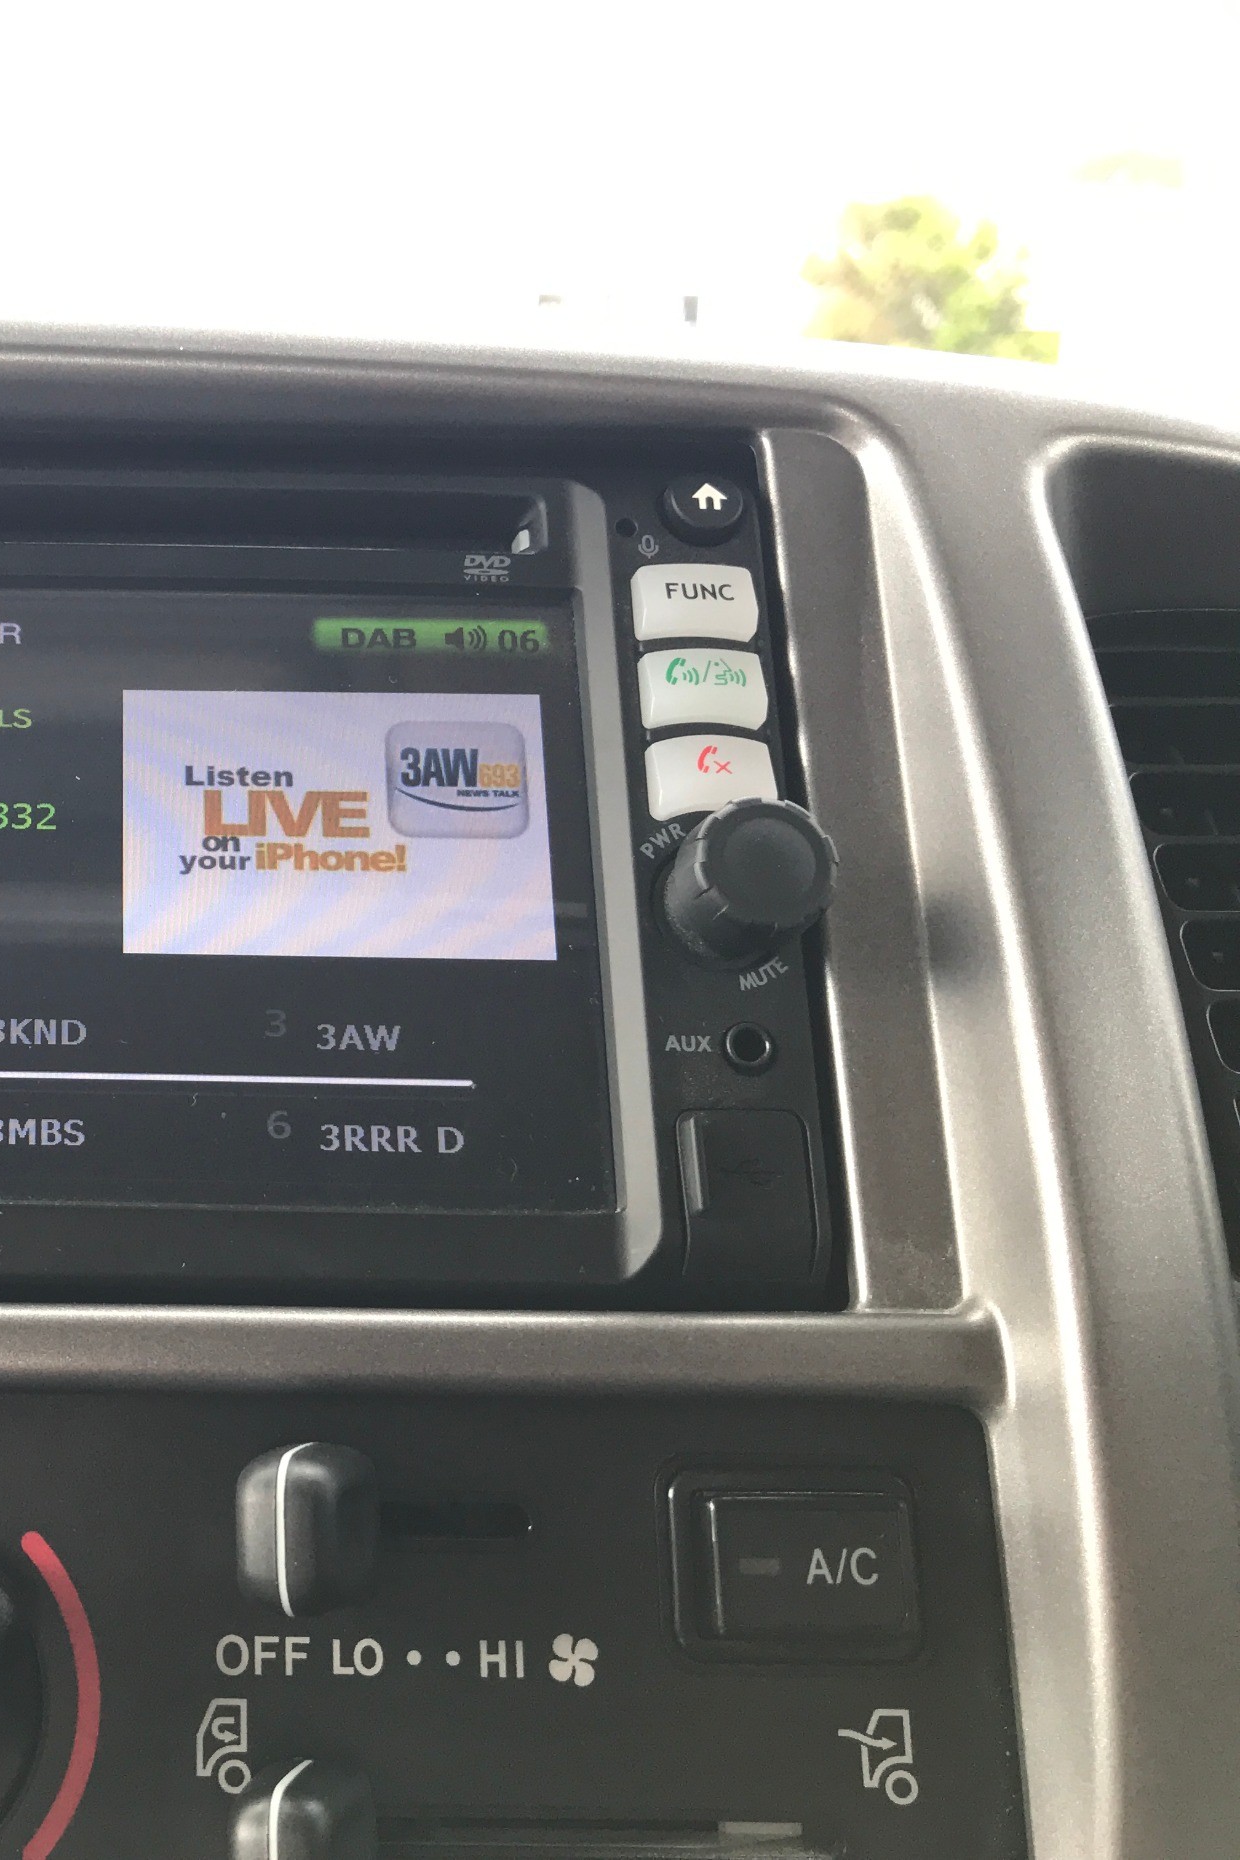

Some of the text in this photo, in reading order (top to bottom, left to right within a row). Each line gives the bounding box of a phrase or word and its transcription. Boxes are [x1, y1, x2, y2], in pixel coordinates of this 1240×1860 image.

[463, 554, 512, 570] DVD
[463, 575, 510, 583] VIDEO
[665, 581, 736, 602] FUNC
[340, 627, 418, 650] DAB
[497, 629, 541, 654] 06
[185, 765, 293, 787] Listen
[457, 789, 520, 798] NEWS TALK
[204, 790, 371, 838] LIVE
[202, 836, 241, 852] on
[640, 822, 686, 859] PWR
[179, 843, 407, 874] your iPhone!
[739, 956, 789, 991] MUTE
[264, 1010, 288, 1040] 3
[316, 1023, 401, 1051] 3AW
[665, 1035, 713, 1054] AUX
[267, 1110, 291, 1141] 6
[320, 1125, 465, 1154] 3RRR D
[805, 1547, 880, 1587] A/C
[215, 1633, 525, 1679] OFF LO HI
